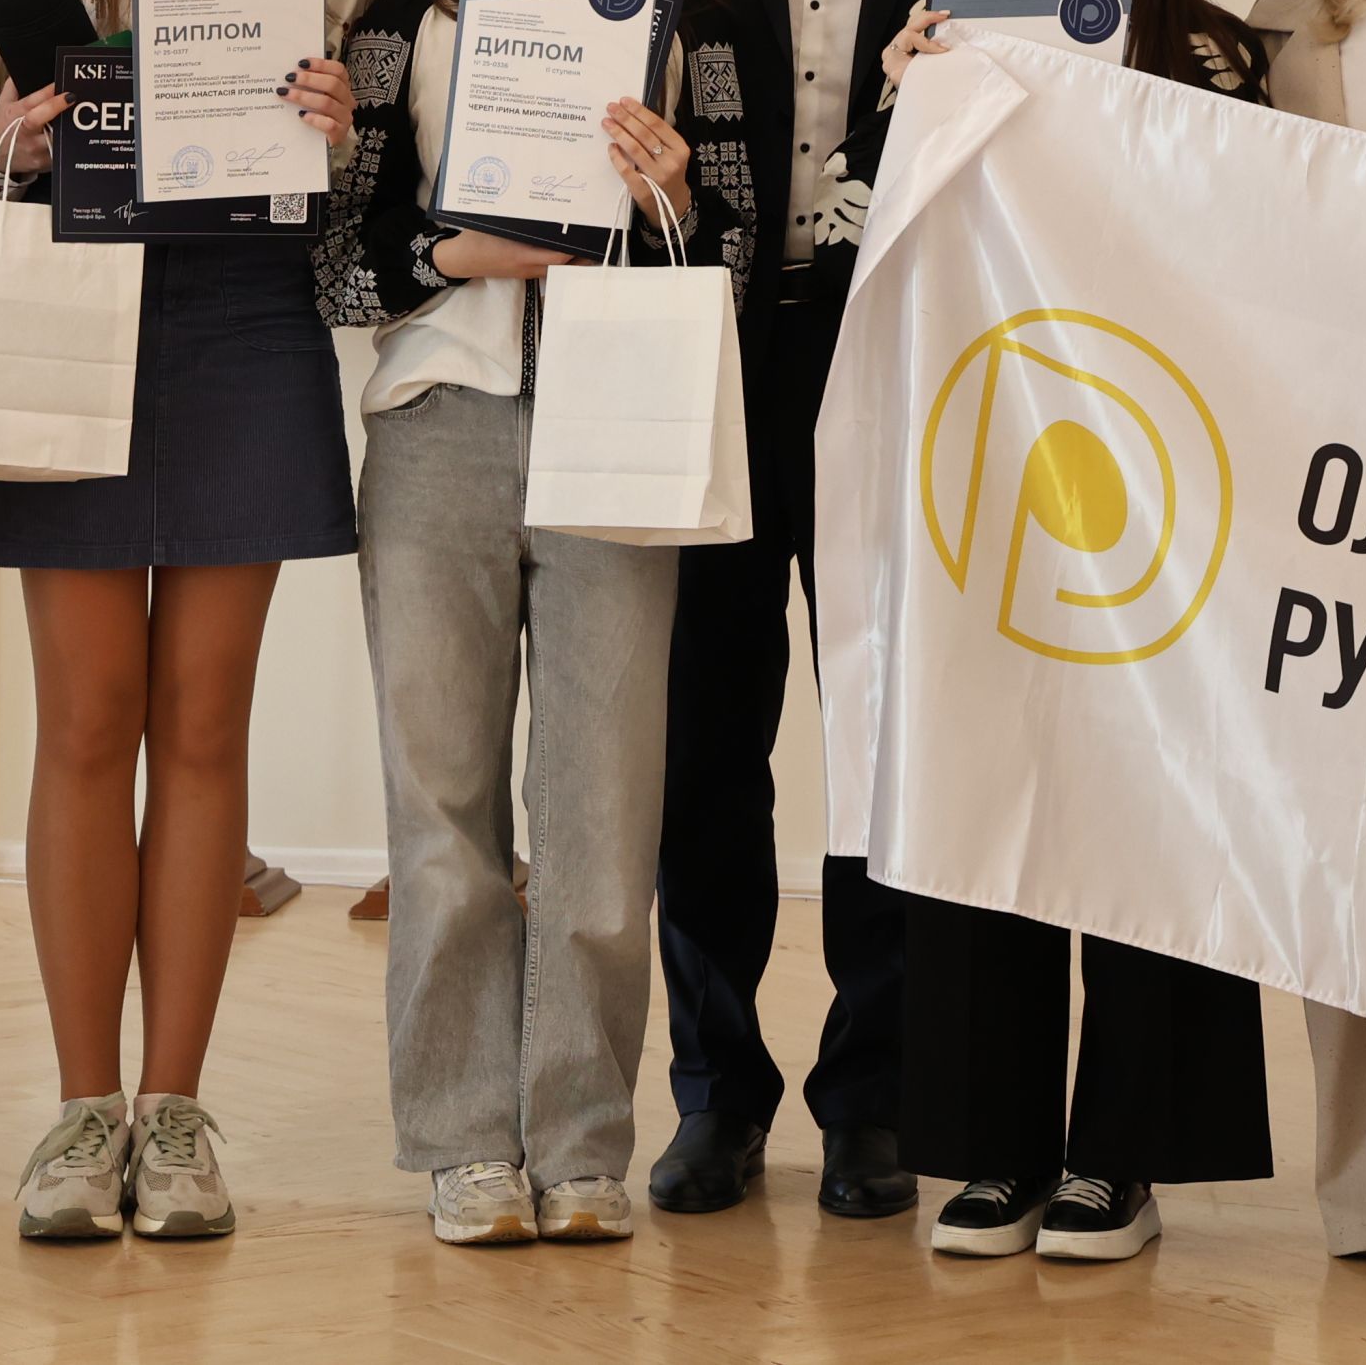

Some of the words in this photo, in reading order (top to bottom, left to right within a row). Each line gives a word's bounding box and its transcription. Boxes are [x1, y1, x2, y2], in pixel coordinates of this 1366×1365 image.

[154, 22, 260, 45] ДИПЛОМ
[475, 36, 582, 62] ДИПЛОМ
[74, 64, 106, 78] KSE
[191, 89, 235, 97] АНАСТАСІЯ
[468, 103, 493, 111] ЧЕРЕП
[495, 106, 519, 114] ІРИНА
[522, 109, 585, 121] МИРОСЛАВІВНА
